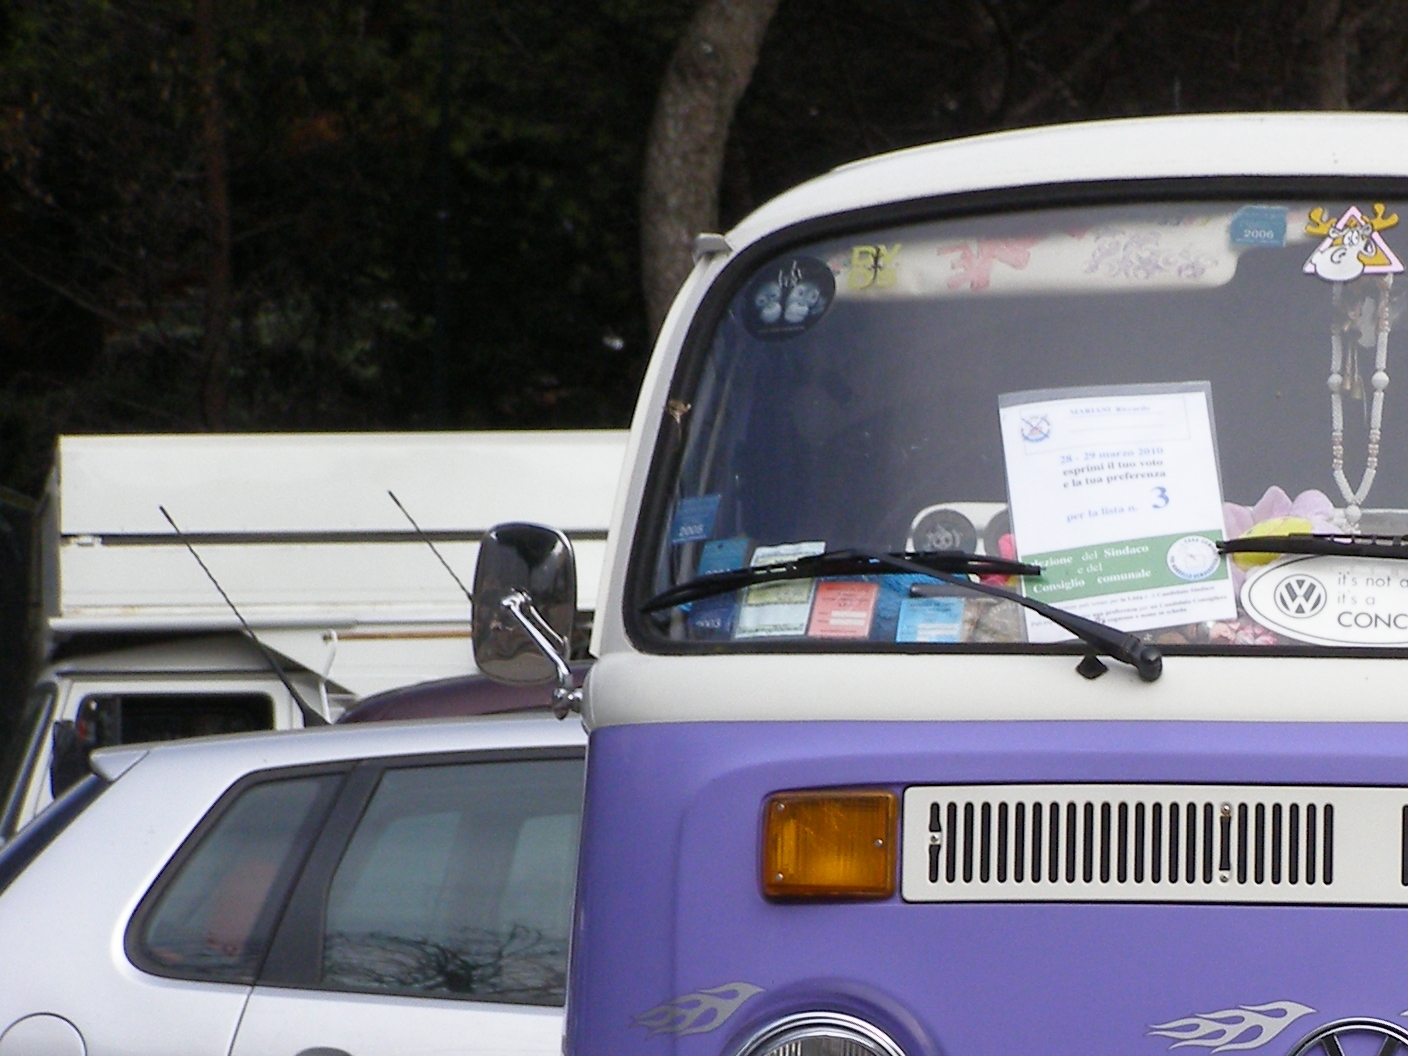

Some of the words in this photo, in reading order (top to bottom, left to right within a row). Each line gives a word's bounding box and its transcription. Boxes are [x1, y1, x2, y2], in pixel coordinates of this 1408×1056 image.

[1243, 229, 1274, 239] 2006
[1060, 454, 1073, 465] 28
[1084, 451, 1096, 461] 29
[1099, 449, 1135, 459] marzo
[1138, 447, 1164, 456] 2010
[1062, 463, 1105, 477] esprimi
[1107, 460, 1115, 470] il
[1118, 460, 1137, 468] tuo
[1140, 458, 1164, 467] voto
[1063, 481, 1069, 489] e
[1071, 476, 1082, 487] la
[1085, 475, 1104, 485] tua
[1106, 470, 1167, 485] preferenza
[1066, 512, 1086, 523] per
[1088, 510, 1099, 519] la
[1101, 505, 1126, 516] lista
[1151, 486, 1170, 509] 3
[1030, 556, 1073, 567] lezione
[1081, 550, 1098, 561] del
[1104, 544, 1149, 558] Sindaco
[1077, 567, 1084, 575] e
[1086, 562, 1103, 574] del
[1033, 577, 1086, 594] Consiglio
[1097, 569, 1151, 585] comunale
[1337, 571, 1358, 586] it's
[1366, 574, 1391, 588] not
[1337, 590, 1358, 605] it's
[1366, 596, 1376, 606] a
